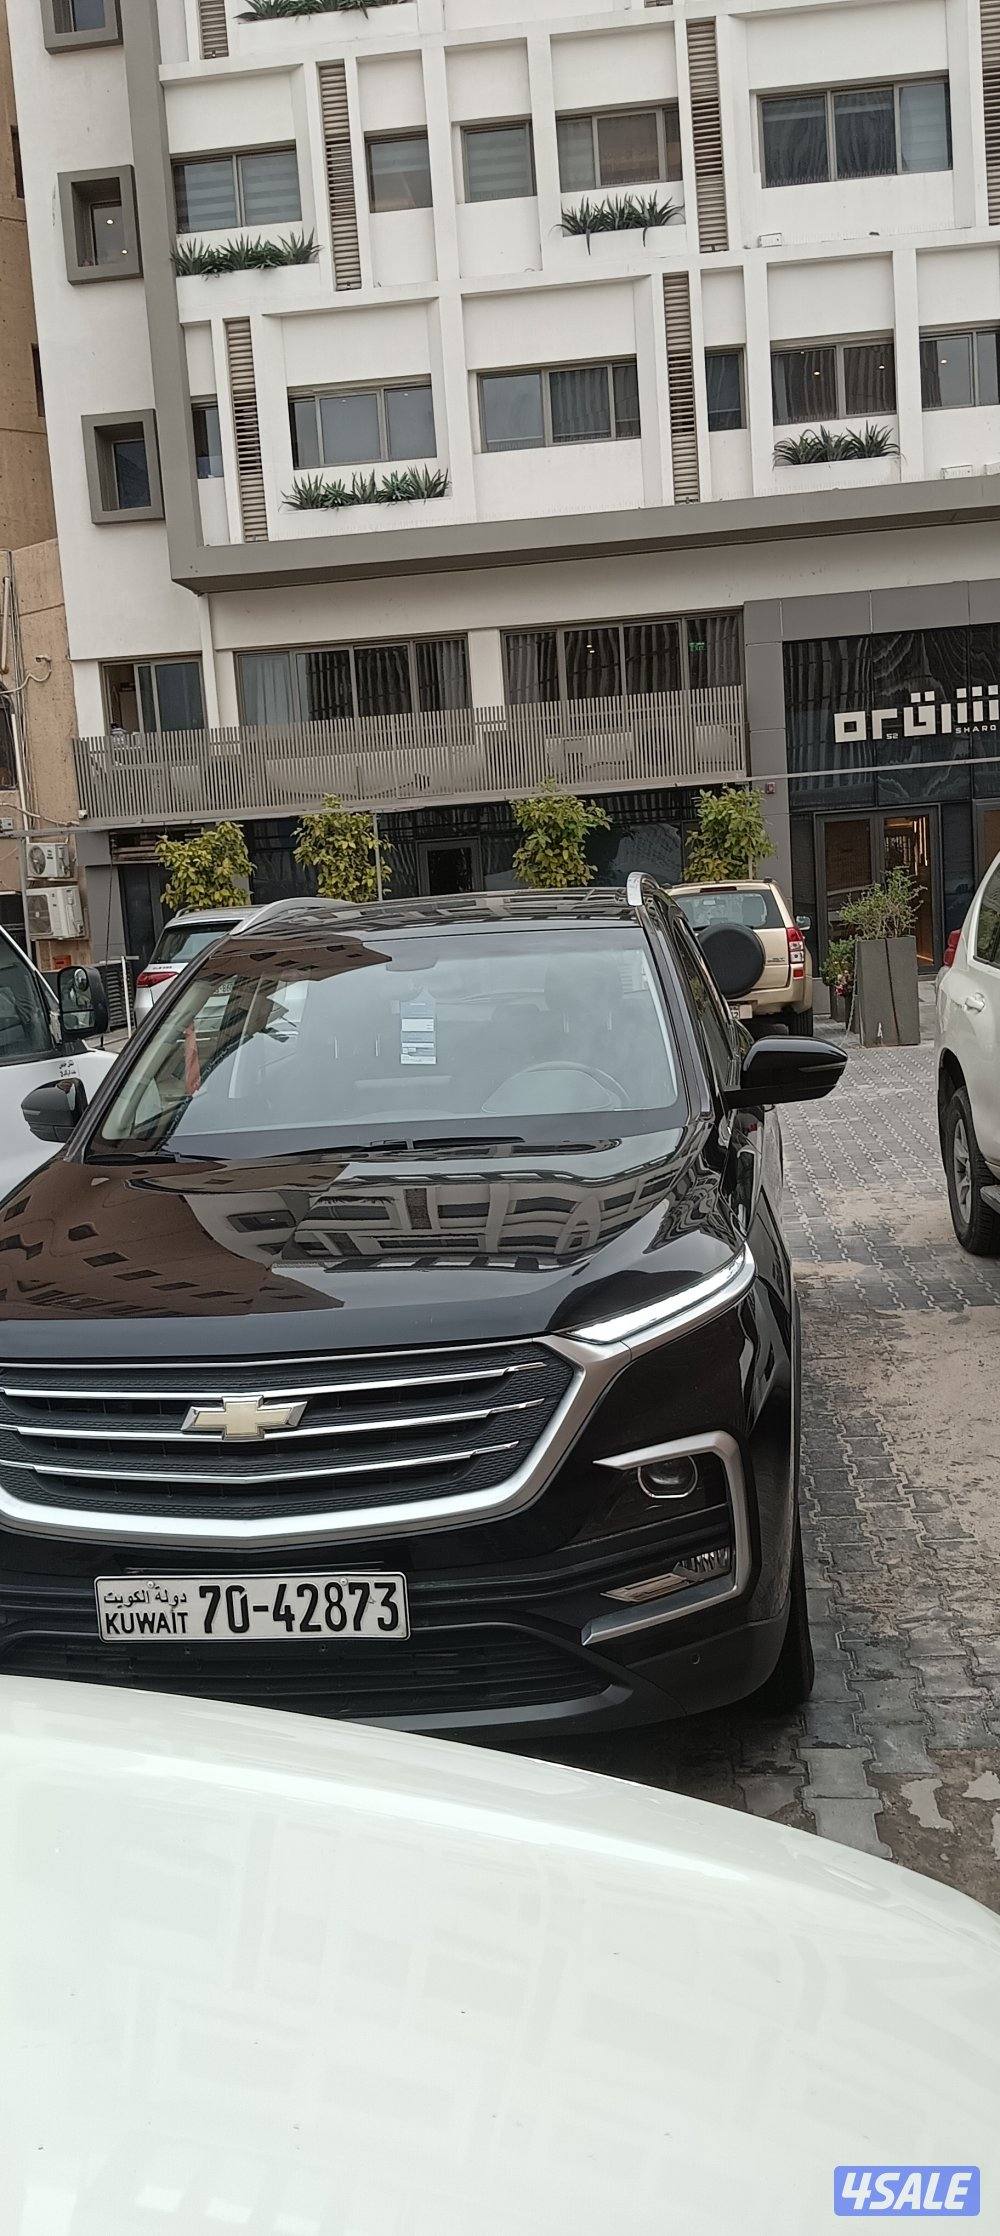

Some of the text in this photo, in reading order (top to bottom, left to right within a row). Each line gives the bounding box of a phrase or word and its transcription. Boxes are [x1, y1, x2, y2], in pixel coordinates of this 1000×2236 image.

[886, 732, 899, 740] 52
[955, 724, 997, 734] SHARQ
[103, 1585, 187, 1608] دولة الكويت
[199, 1582, 400, 1635] 70-42873
[105, 1612, 189, 1635] KUWAIT
